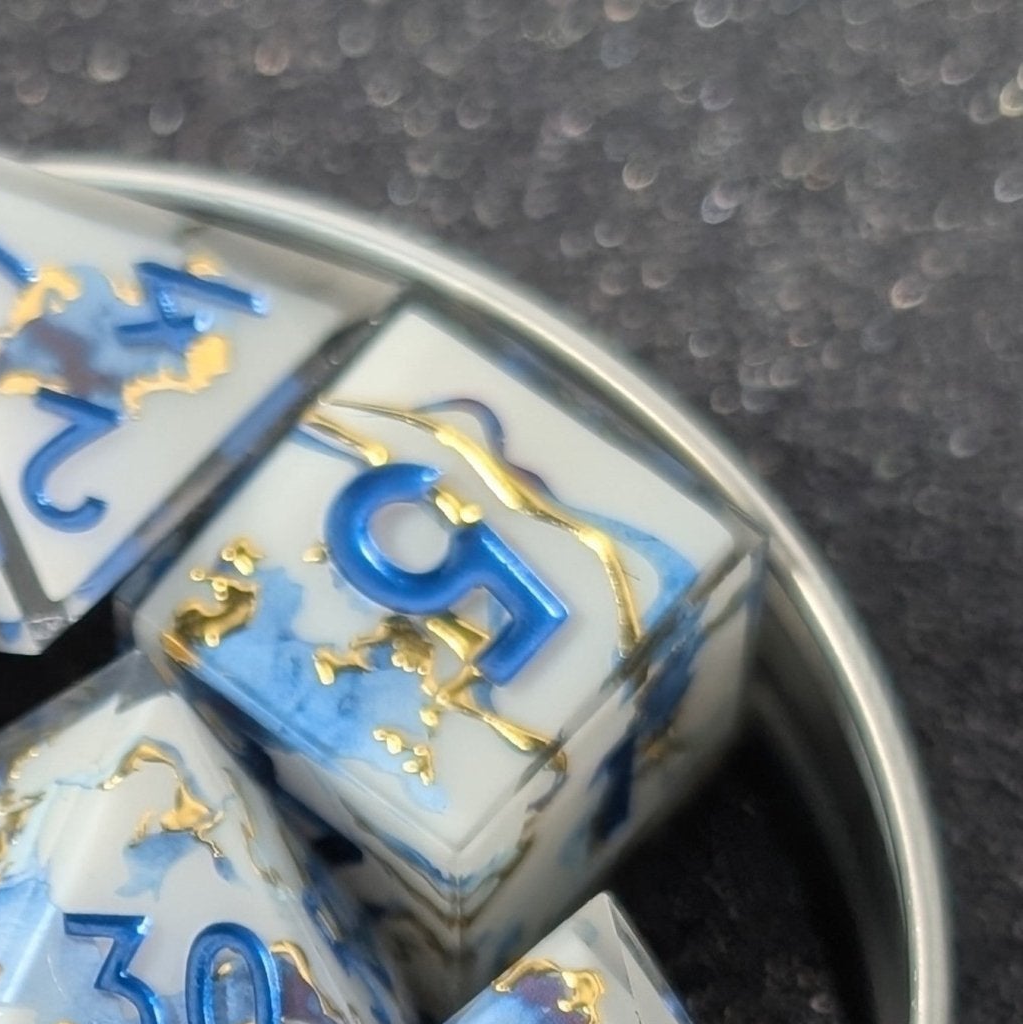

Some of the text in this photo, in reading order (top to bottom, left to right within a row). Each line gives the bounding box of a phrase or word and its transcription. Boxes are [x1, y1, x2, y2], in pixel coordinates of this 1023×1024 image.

[114, 262, 270, 353] 4
[22, 386, 123, 533] 2
[324, 462, 569, 686] 5
